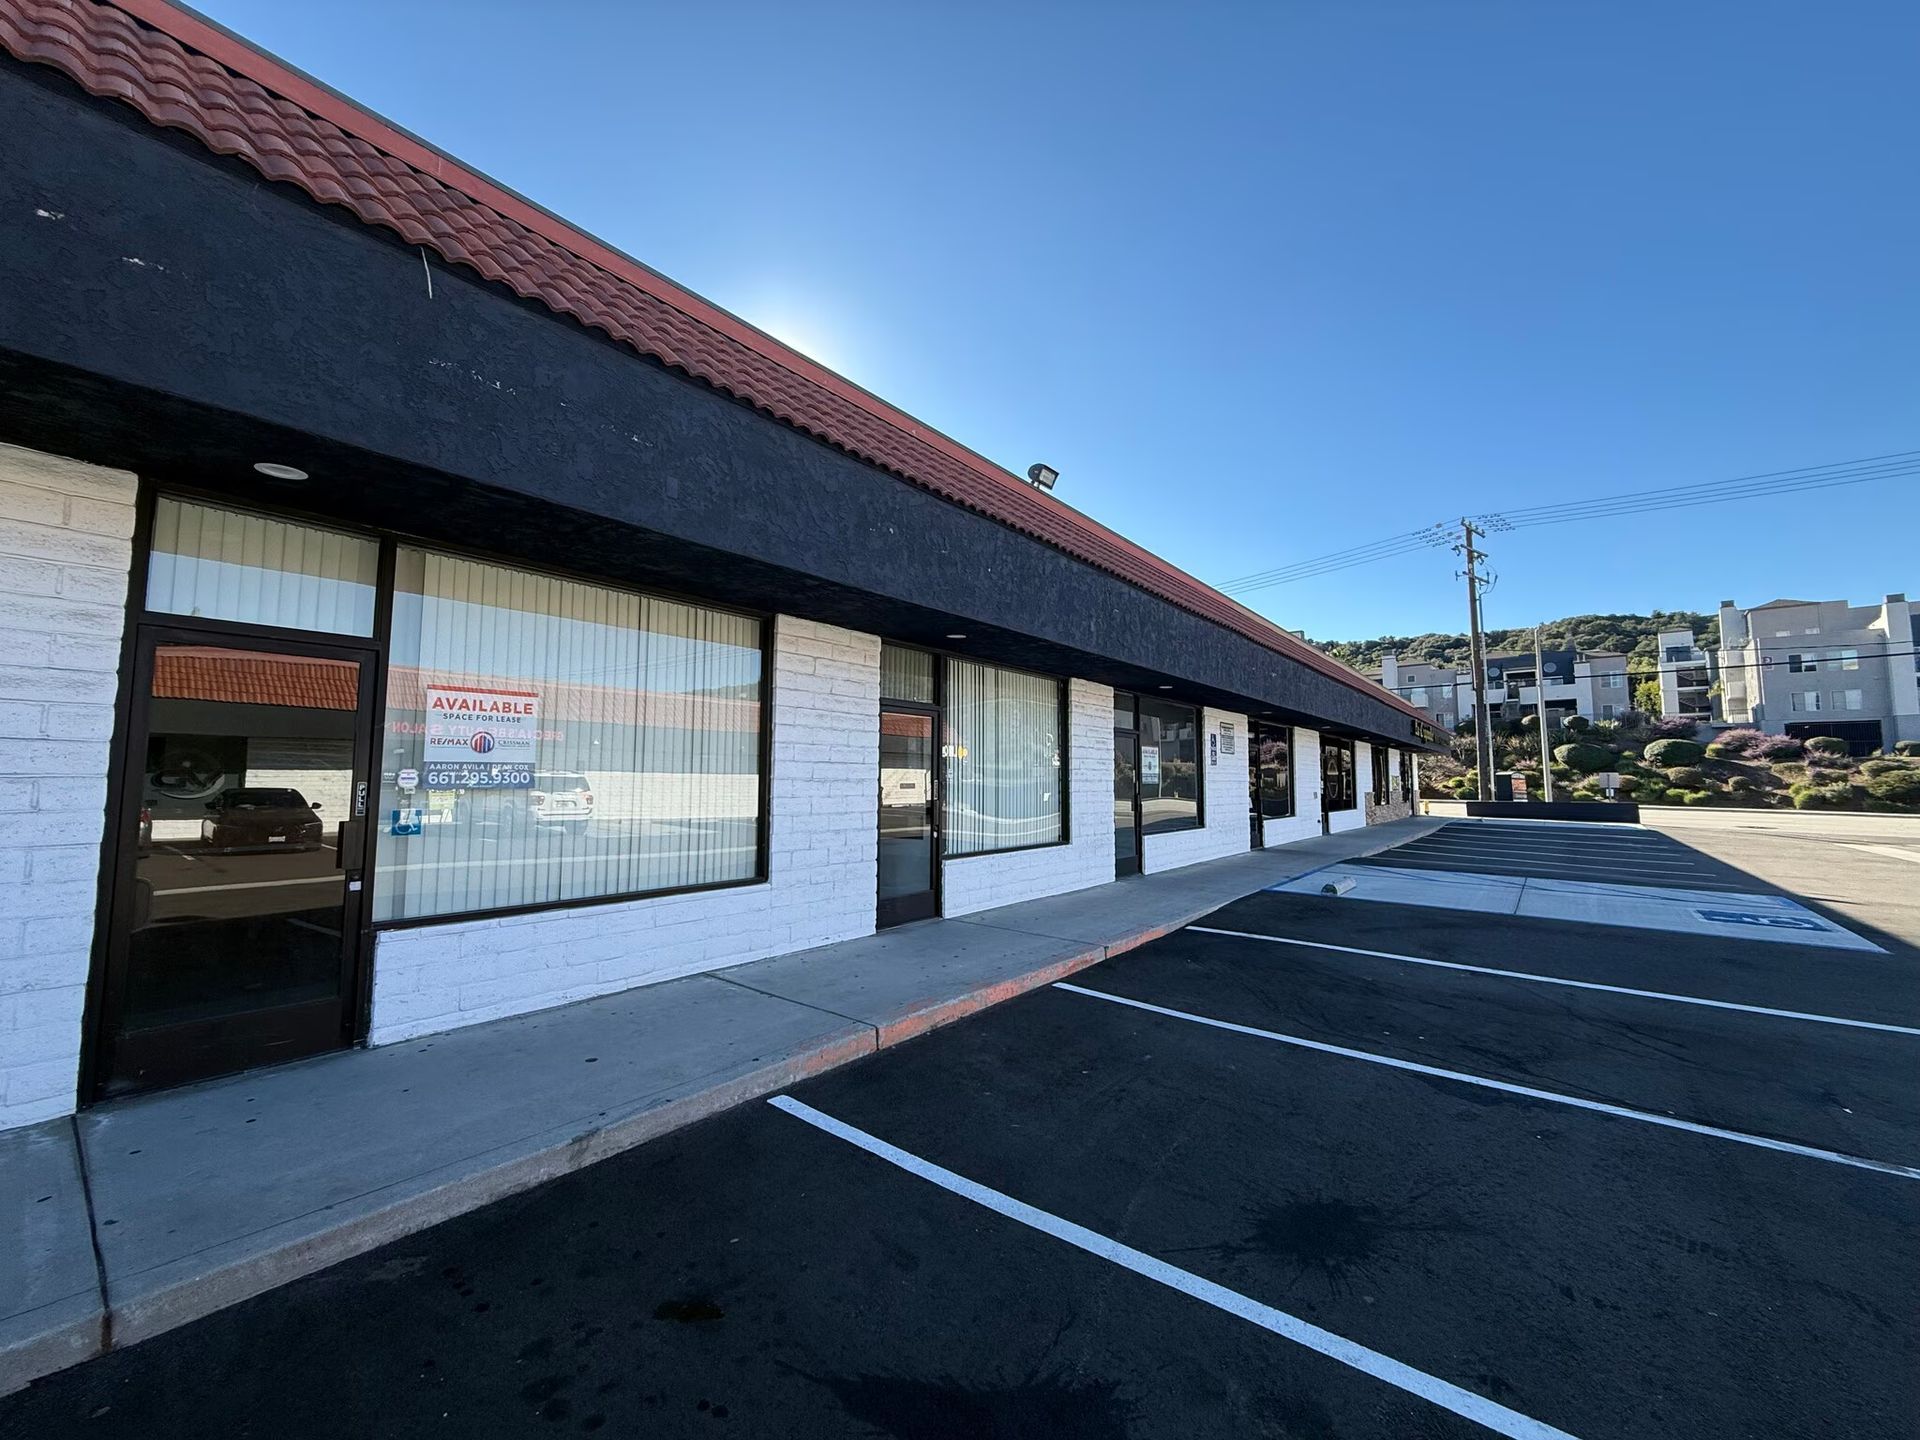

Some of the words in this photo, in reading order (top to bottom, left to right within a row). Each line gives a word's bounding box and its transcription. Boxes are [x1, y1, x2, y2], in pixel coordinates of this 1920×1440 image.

[431, 696, 534, 715] AVAILABLE
[443, 713, 473, 721] SPACE
[476, 714, 494, 722] FOR
[495, 715, 521, 723] LEASE
[430, 737, 468, 747] RE/MAX
[428, 771, 531, 785] 661.295.9300
